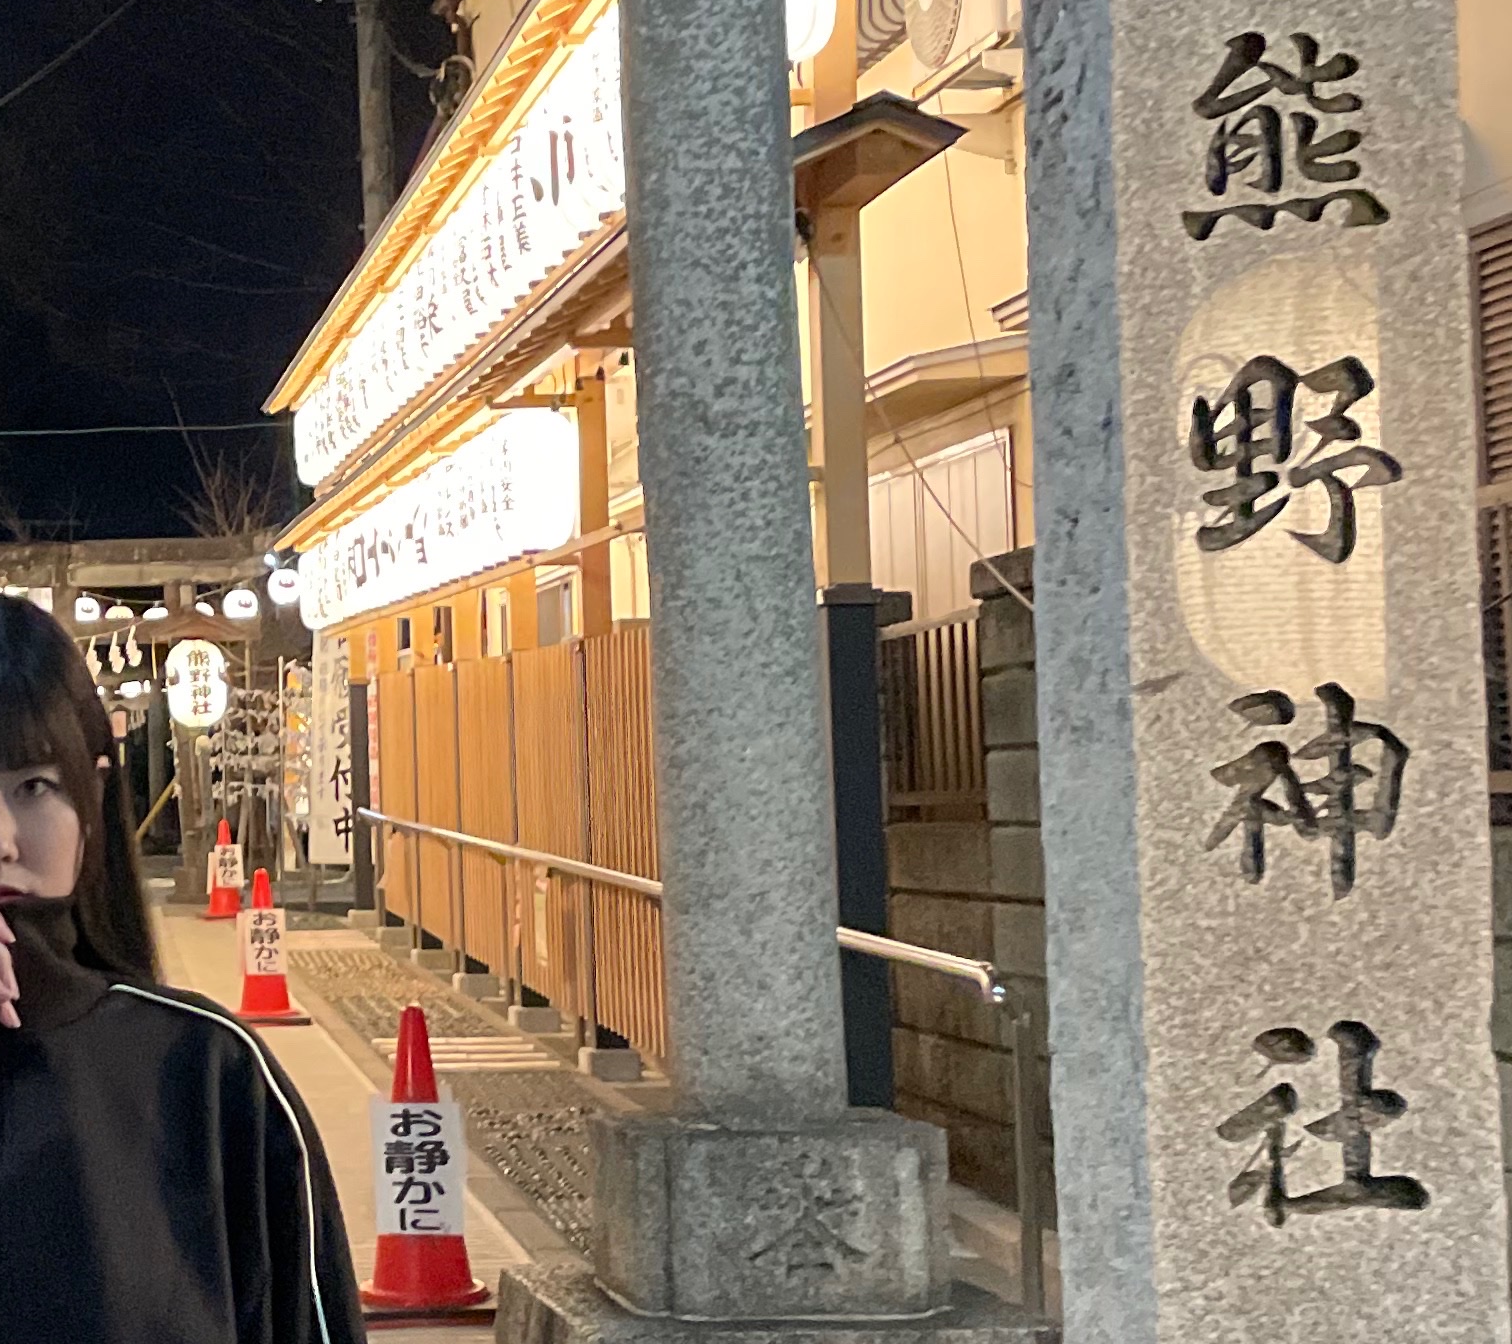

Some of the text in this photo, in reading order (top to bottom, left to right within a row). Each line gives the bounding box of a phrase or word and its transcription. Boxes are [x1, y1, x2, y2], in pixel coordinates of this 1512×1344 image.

[1181, 30, 1432, 1229] 熊野神社
[186, 648, 213, 716] 熊野神社
[250, 912, 281, 974] お静かに
[383, 1107, 451, 1233] お静かに
